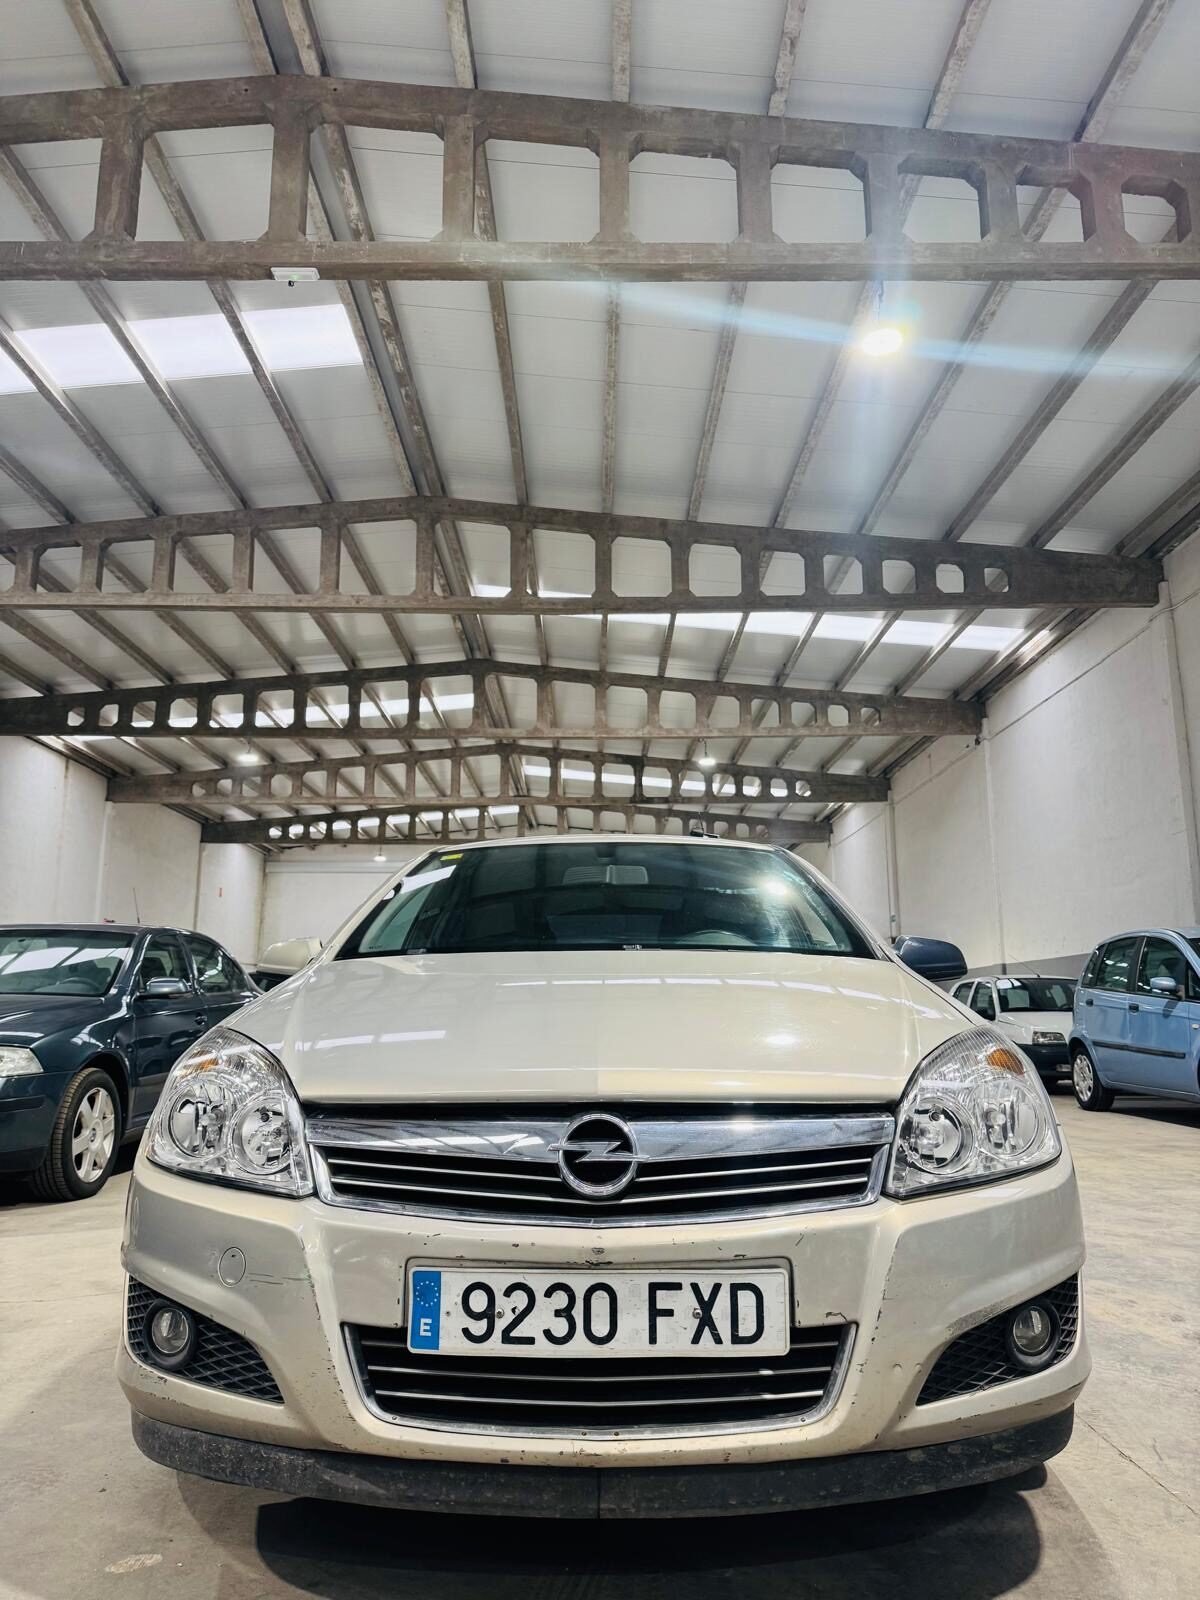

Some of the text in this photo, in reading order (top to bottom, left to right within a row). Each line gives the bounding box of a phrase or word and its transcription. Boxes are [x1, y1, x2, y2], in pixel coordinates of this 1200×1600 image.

[419, 1317, 433, 1337] E
[461, 1281, 765, 1345] 9230 FXD
